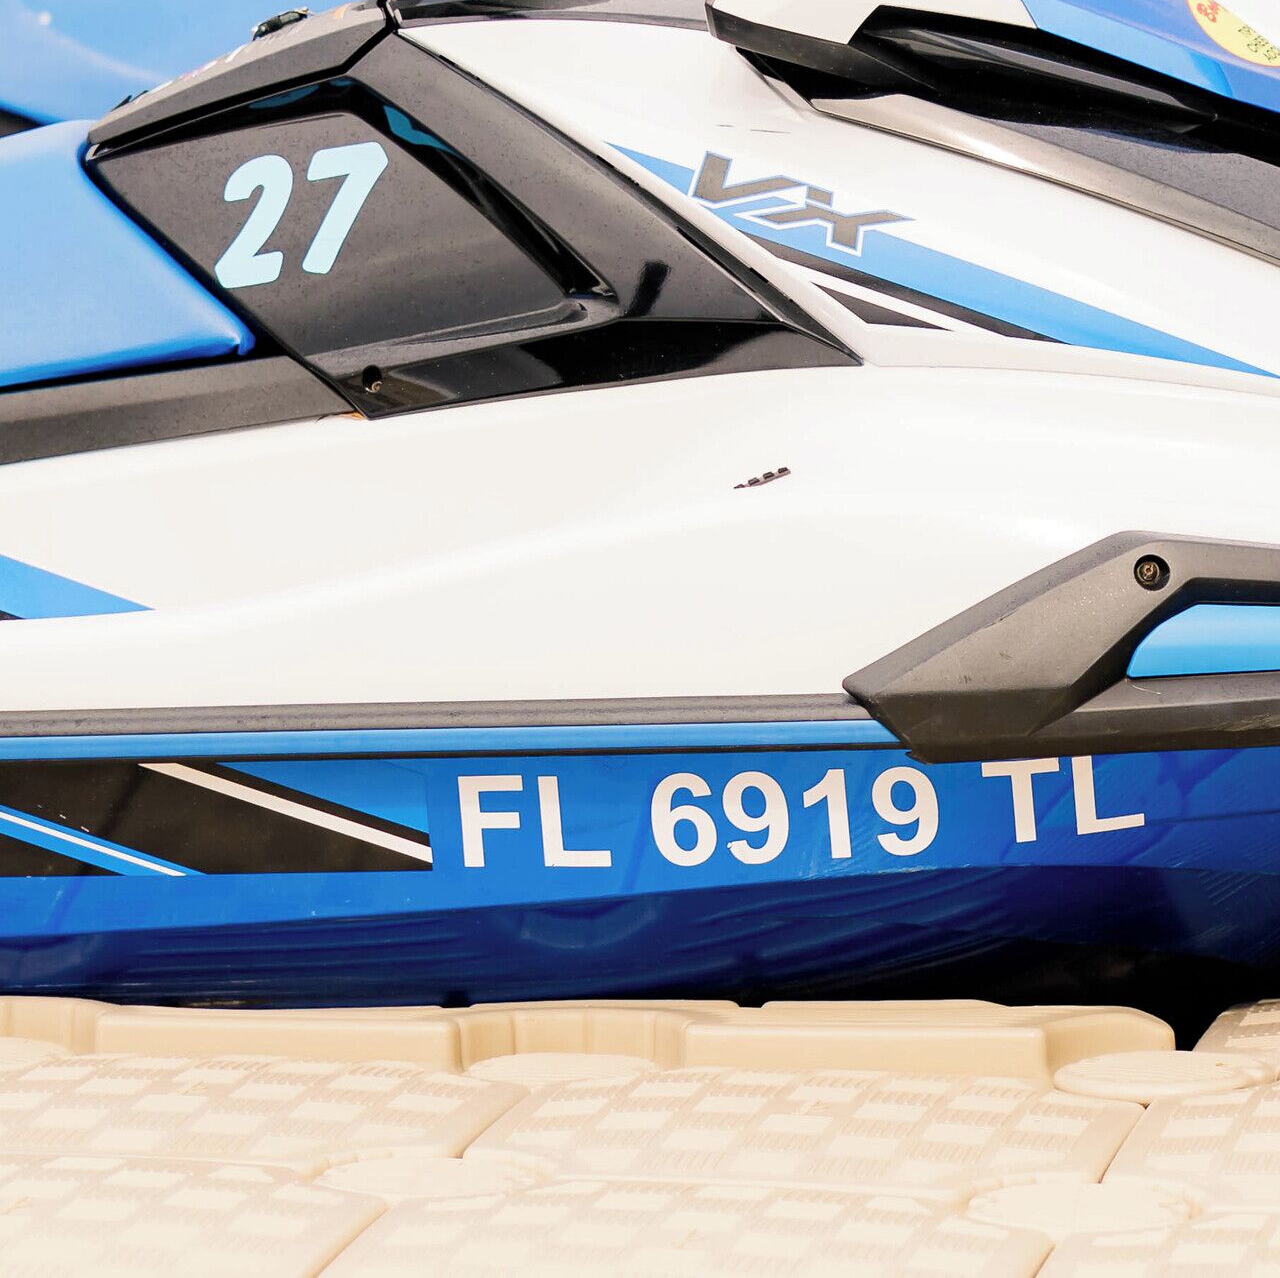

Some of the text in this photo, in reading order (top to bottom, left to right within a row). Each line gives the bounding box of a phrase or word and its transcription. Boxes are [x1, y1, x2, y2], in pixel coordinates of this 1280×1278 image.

[213, 140, 390, 289] 27
[694, 150, 917, 252] VX
[456, 755, 1146, 868] FL 6919 TL
